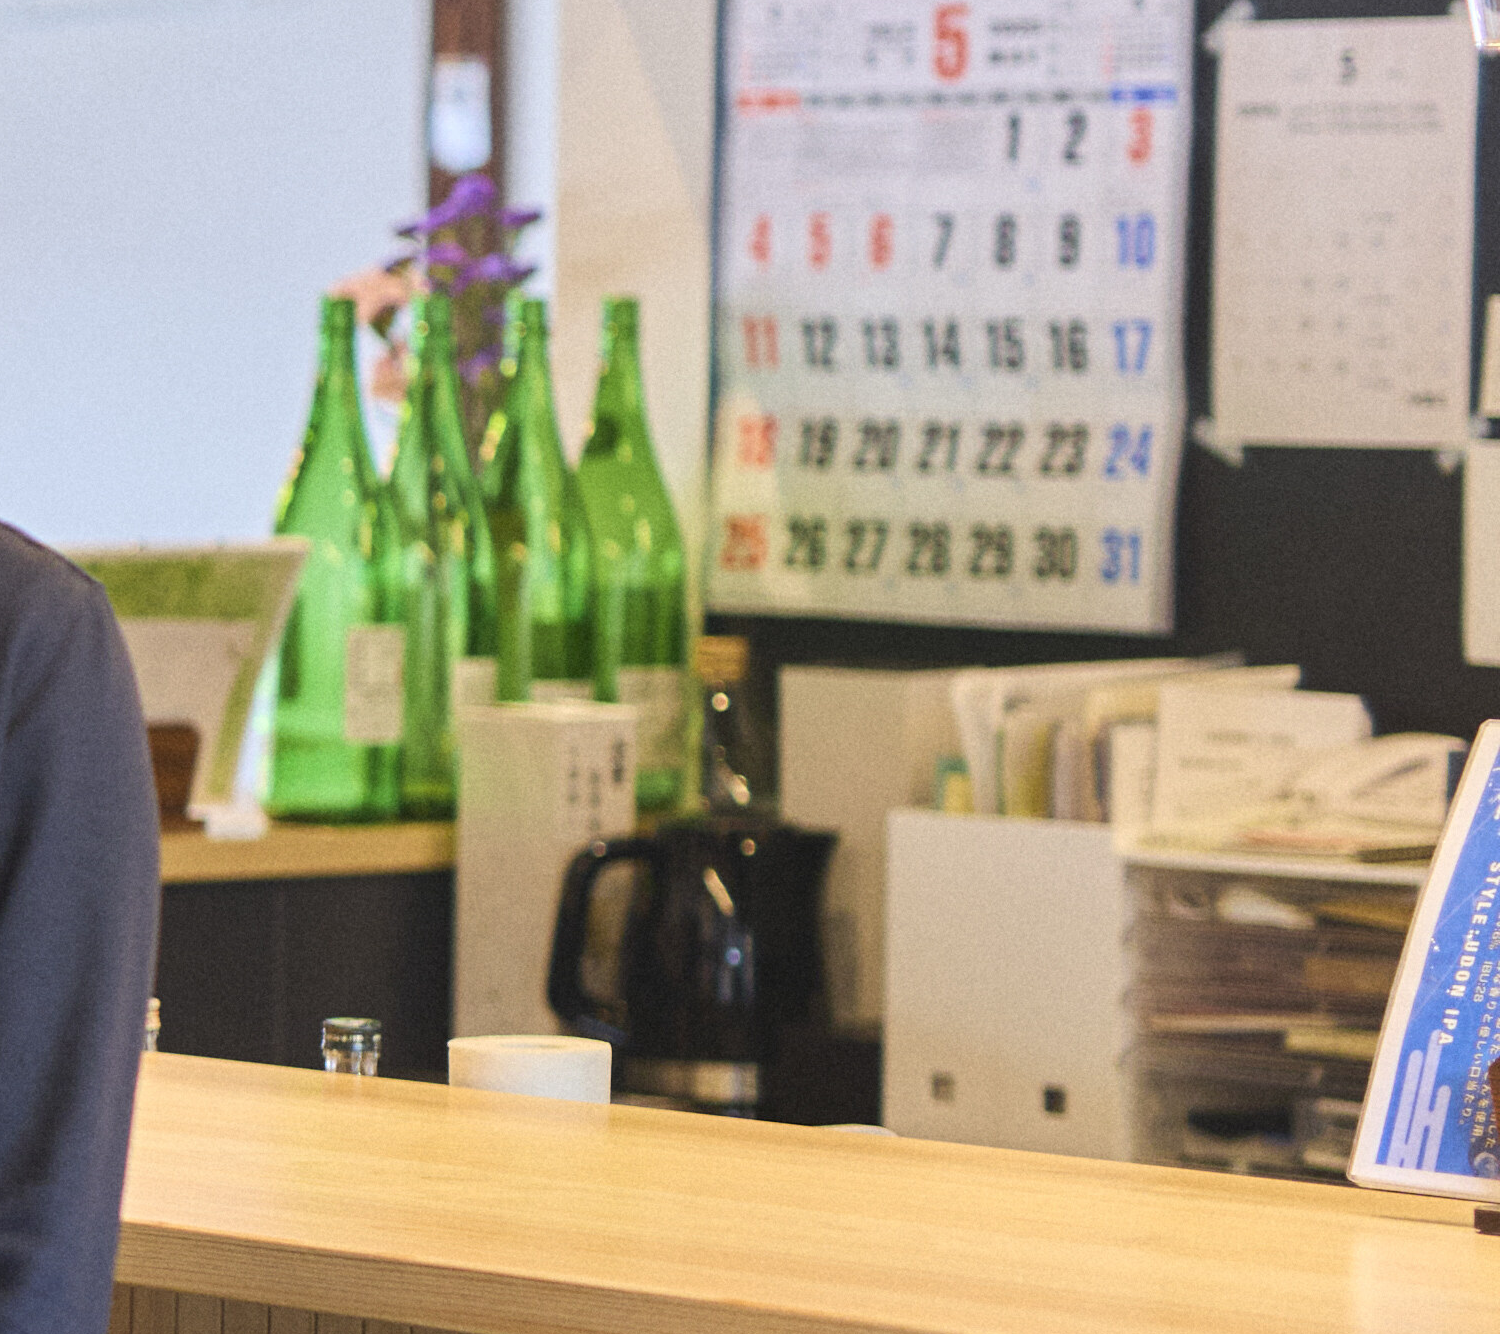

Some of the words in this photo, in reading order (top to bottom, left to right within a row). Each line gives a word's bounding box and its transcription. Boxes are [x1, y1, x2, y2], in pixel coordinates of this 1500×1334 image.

[932, 0, 971, 83] 5
[1007, 111, 1021, 163] 1
[1063, 111, 1088, 165] 2
[1127, 106, 1154, 166] 3
[748, 212, 773, 270] 4
[807, 210, 833, 271] 5
[933, 210, 955, 271] 7
[995, 212, 1018, 271] 8
[1059, 212, 1083, 270] 9
[1116, 212, 1157, 271] 10
[741, 314, 780, 373] 11
[801, 314, 839, 374] 12
[861, 315, 900, 373] 13
[922, 315, 963, 373] 14
[986, 315, 1026, 374] 15
[1048, 316, 1089, 375] 16
[1112, 317, 1155, 376] 17
[801, 414, 840, 472] 19
[853, 415, 900, 475] 20
[917, 416, 961, 475] 21
[976, 417, 1026, 476] 22
[1038, 418, 1090, 476] 23
[1104, 420, 1155, 479] 24
[784, 513, 827, 572] 26
[843, 516, 890, 574] 27
[904, 519, 952, 580] 28
[967, 521, 1016, 581] 29
[1031, 524, 1080, 582] 30
[1102, 525, 1142, 585] 31
[1473, 960, 1494, 1003] IBU:28
[1438, 1008, 1460, 1045] IPA
